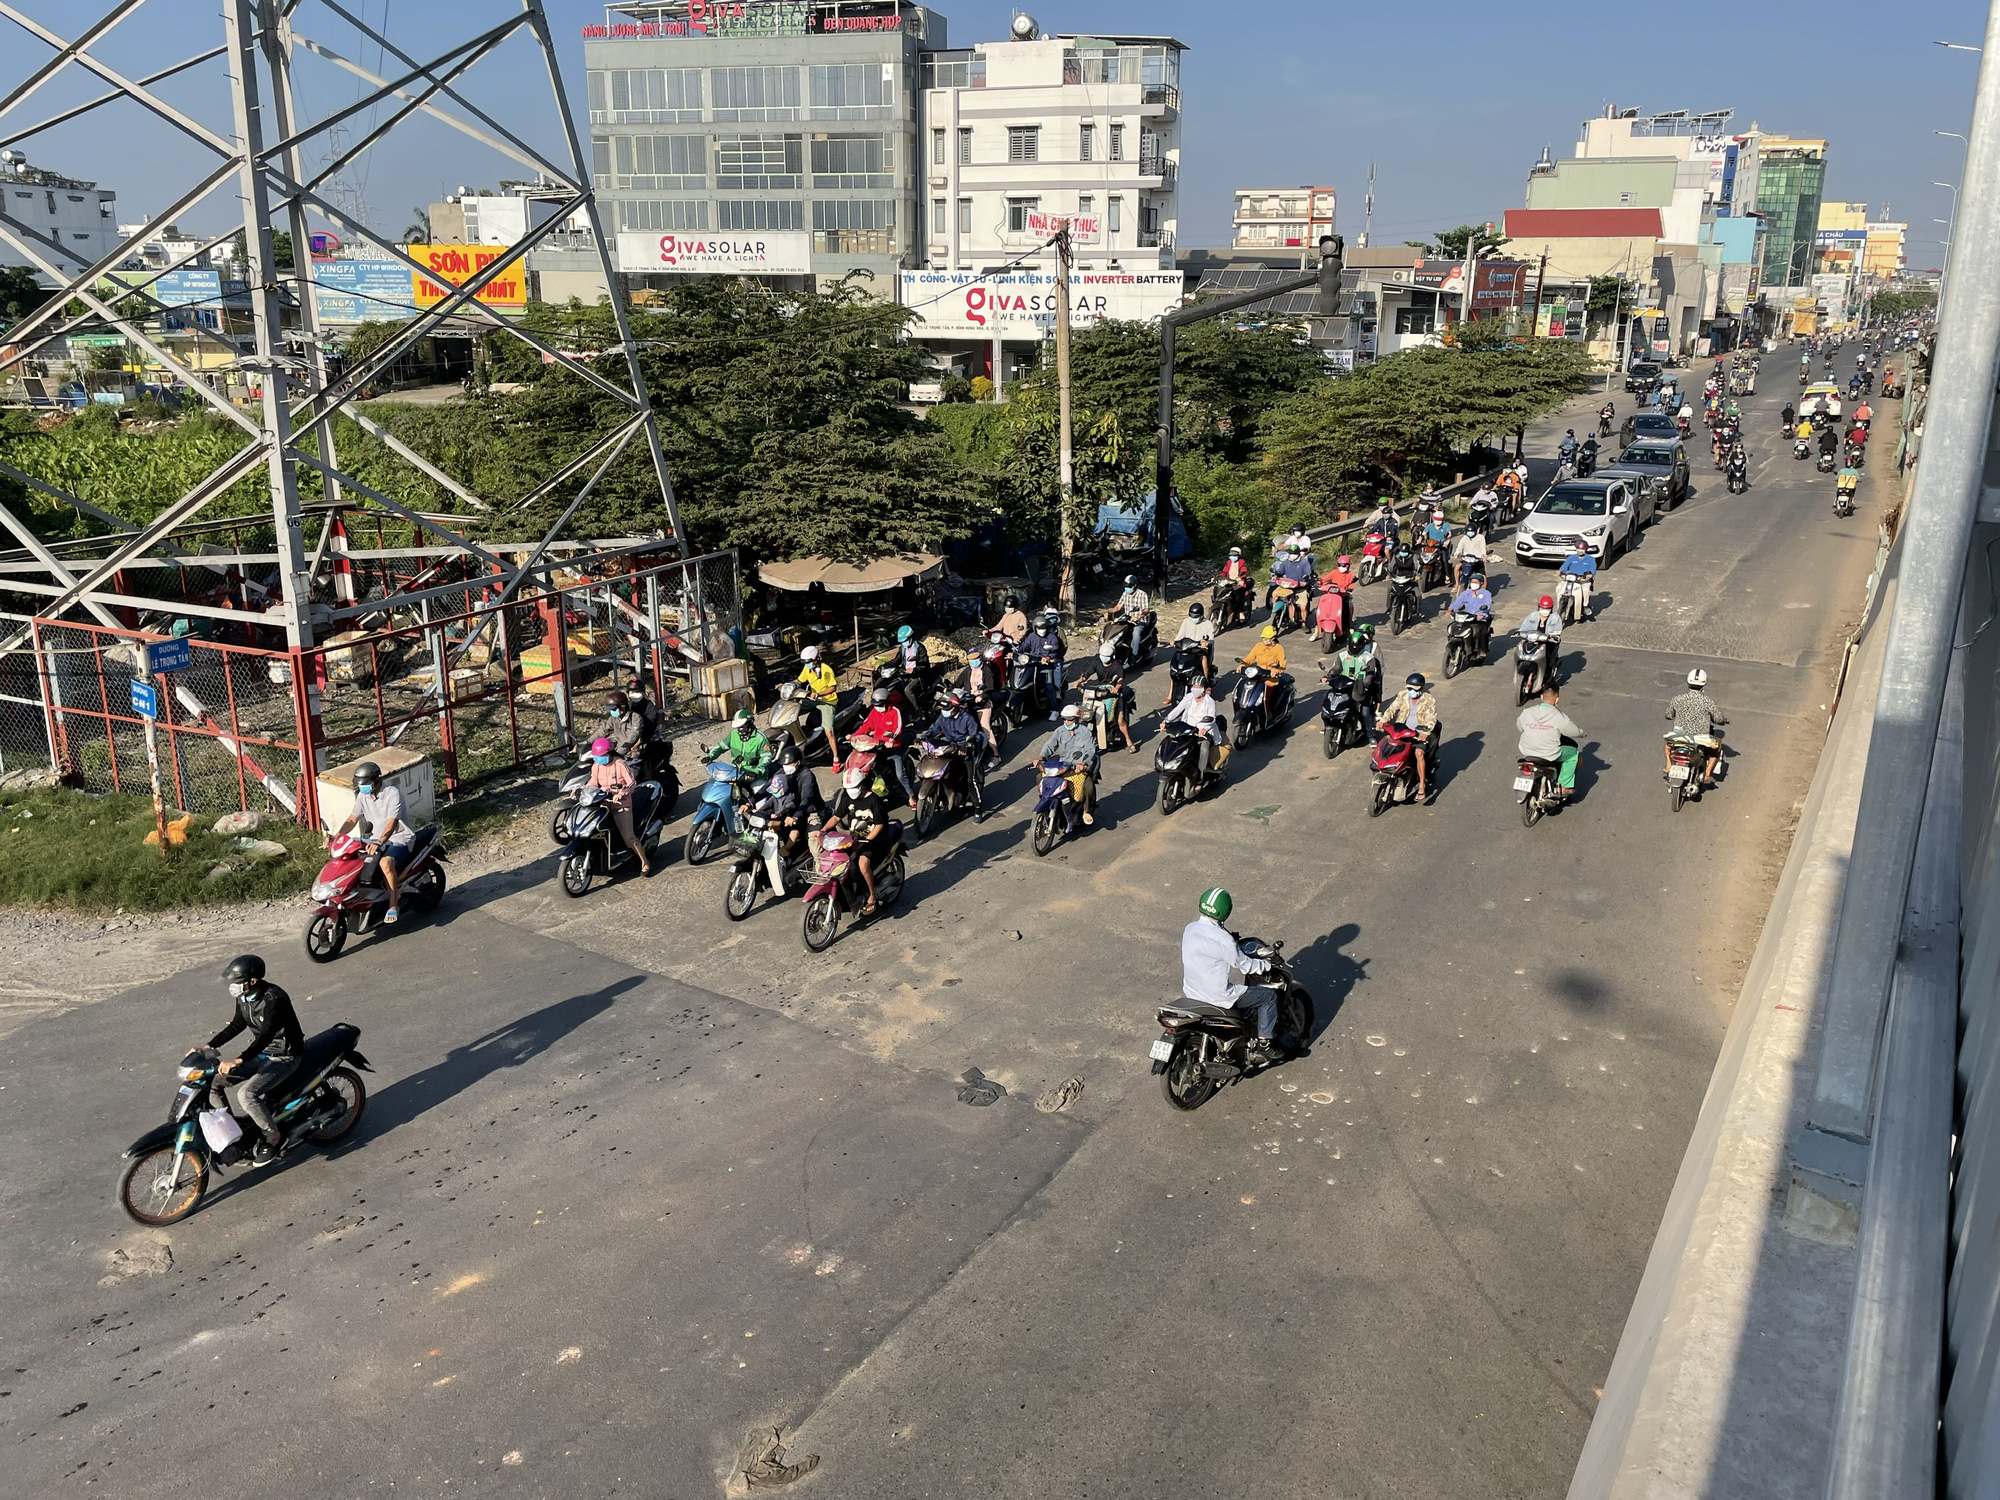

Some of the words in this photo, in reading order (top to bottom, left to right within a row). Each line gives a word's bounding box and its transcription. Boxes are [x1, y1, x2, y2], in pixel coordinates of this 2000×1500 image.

[1029, 214, 1047, 230] NHÀ
[429, 250, 470, 273] SƠN
[320, 265, 355, 273] XINGFA
[188, 272, 201, 280] CÔNG
[1019, 273, 1043, 286] KIỆN
[1045, 275, 1081, 284] SOAR
[1084, 275, 1135, 284] INVERTER
[1137, 275, 1182, 284] BATTERY
[476, 278, 517, 298] PHÁT
[1000, 313, 1014, 321] WE
[1019, 313, 1047, 321] HAVE
[287, 518, 301, 527] 06
[152, 657, 158, 669] LÊ
[160, 655, 177, 669] TRỌNG
[179, 650, 189, 663] TẤN
[132, 697, 150, 711] CN1
